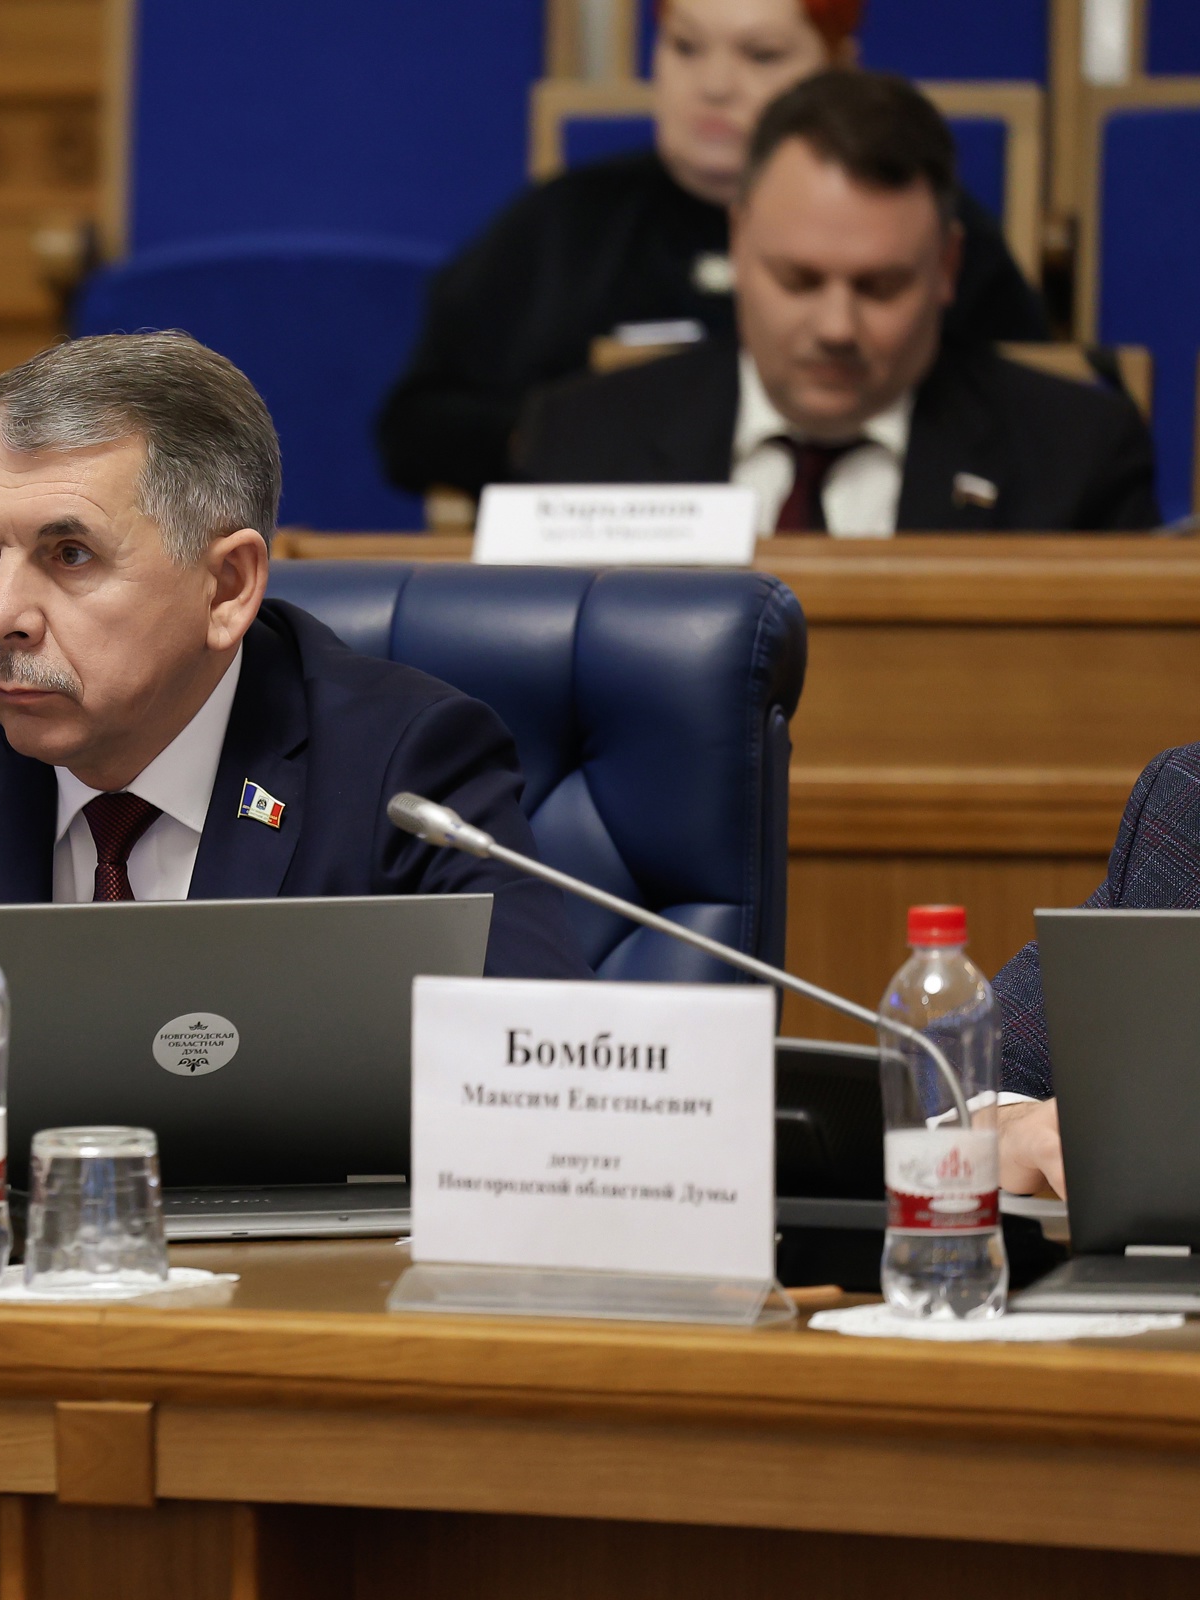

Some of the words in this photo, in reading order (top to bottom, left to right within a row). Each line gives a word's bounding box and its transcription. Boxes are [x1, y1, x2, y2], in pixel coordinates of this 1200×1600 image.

[160, 1032, 235, 1041] НОВГОРОДСКАЯ
[168, 1040, 225, 1048] ОБЛАСТНАЯ
[181, 1048, 209, 1056] ДУМА
[506, 1028, 668, 1071] Бомбин
[462, 1083, 561, 1110] Максим
[568, 1086, 714, 1117] Евгеньевич
[547, 1153, 622, 1174] депутат
[437, 1171, 572, 1198] Новгородской
[575, 1177, 676, 1202] областной
[678, 1183, 739, 1208] Думы
